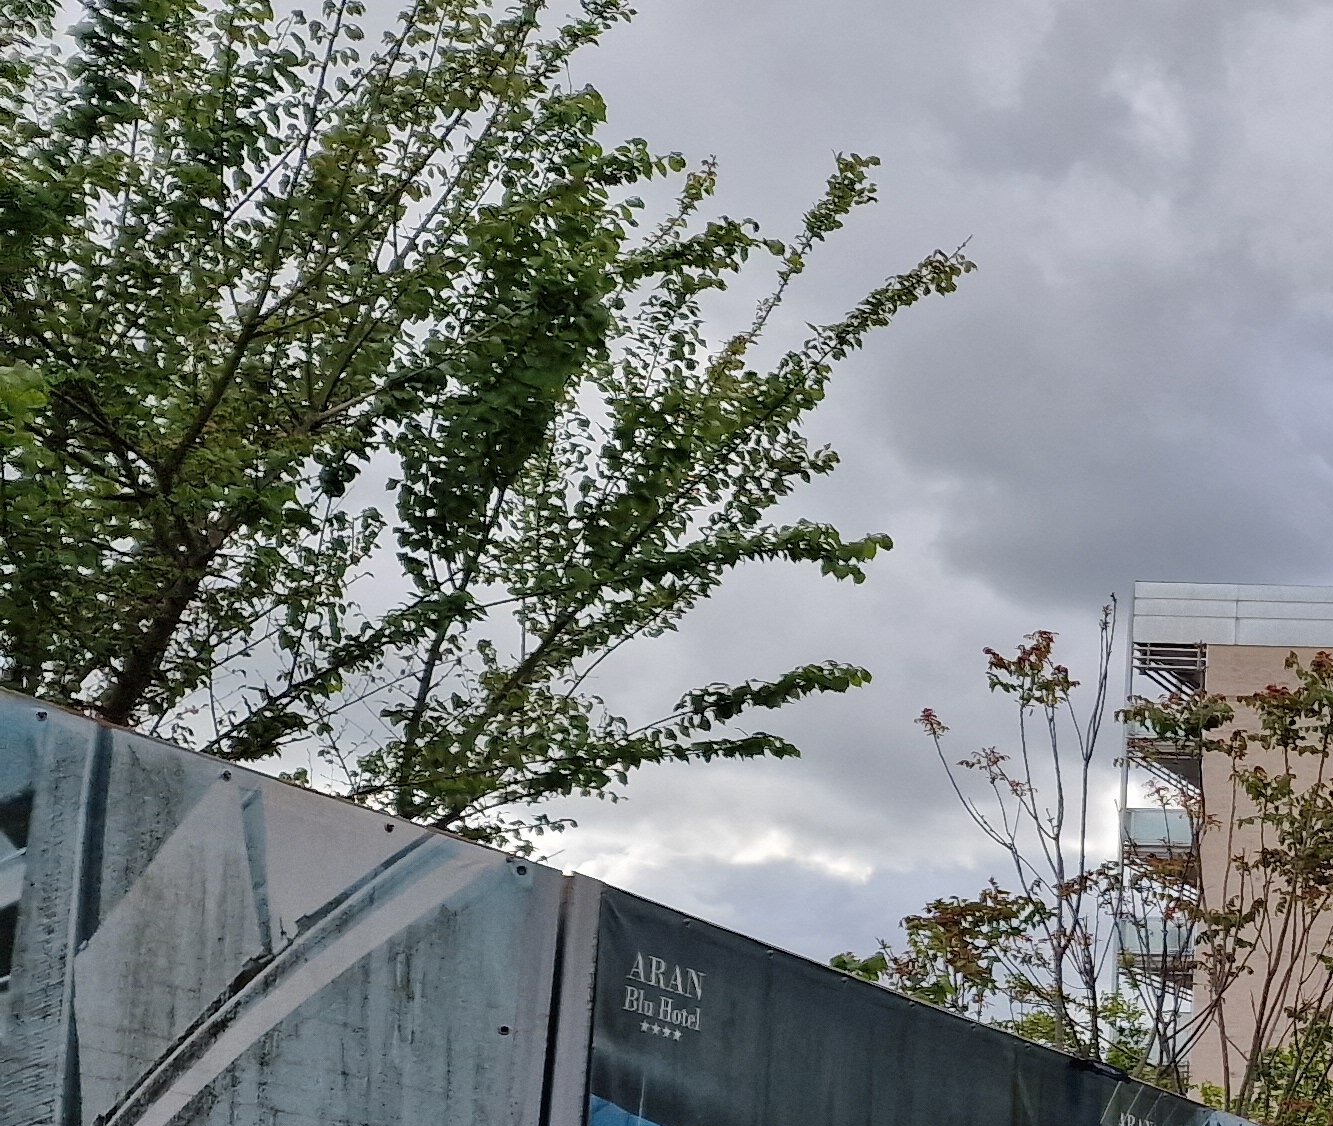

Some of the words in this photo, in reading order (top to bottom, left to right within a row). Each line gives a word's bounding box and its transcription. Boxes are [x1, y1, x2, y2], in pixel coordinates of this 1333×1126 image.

[625, 951, 707, 1001] ARAN
[622, 985, 654, 1016] Blu
[659, 996, 700, 1031] Hotel
